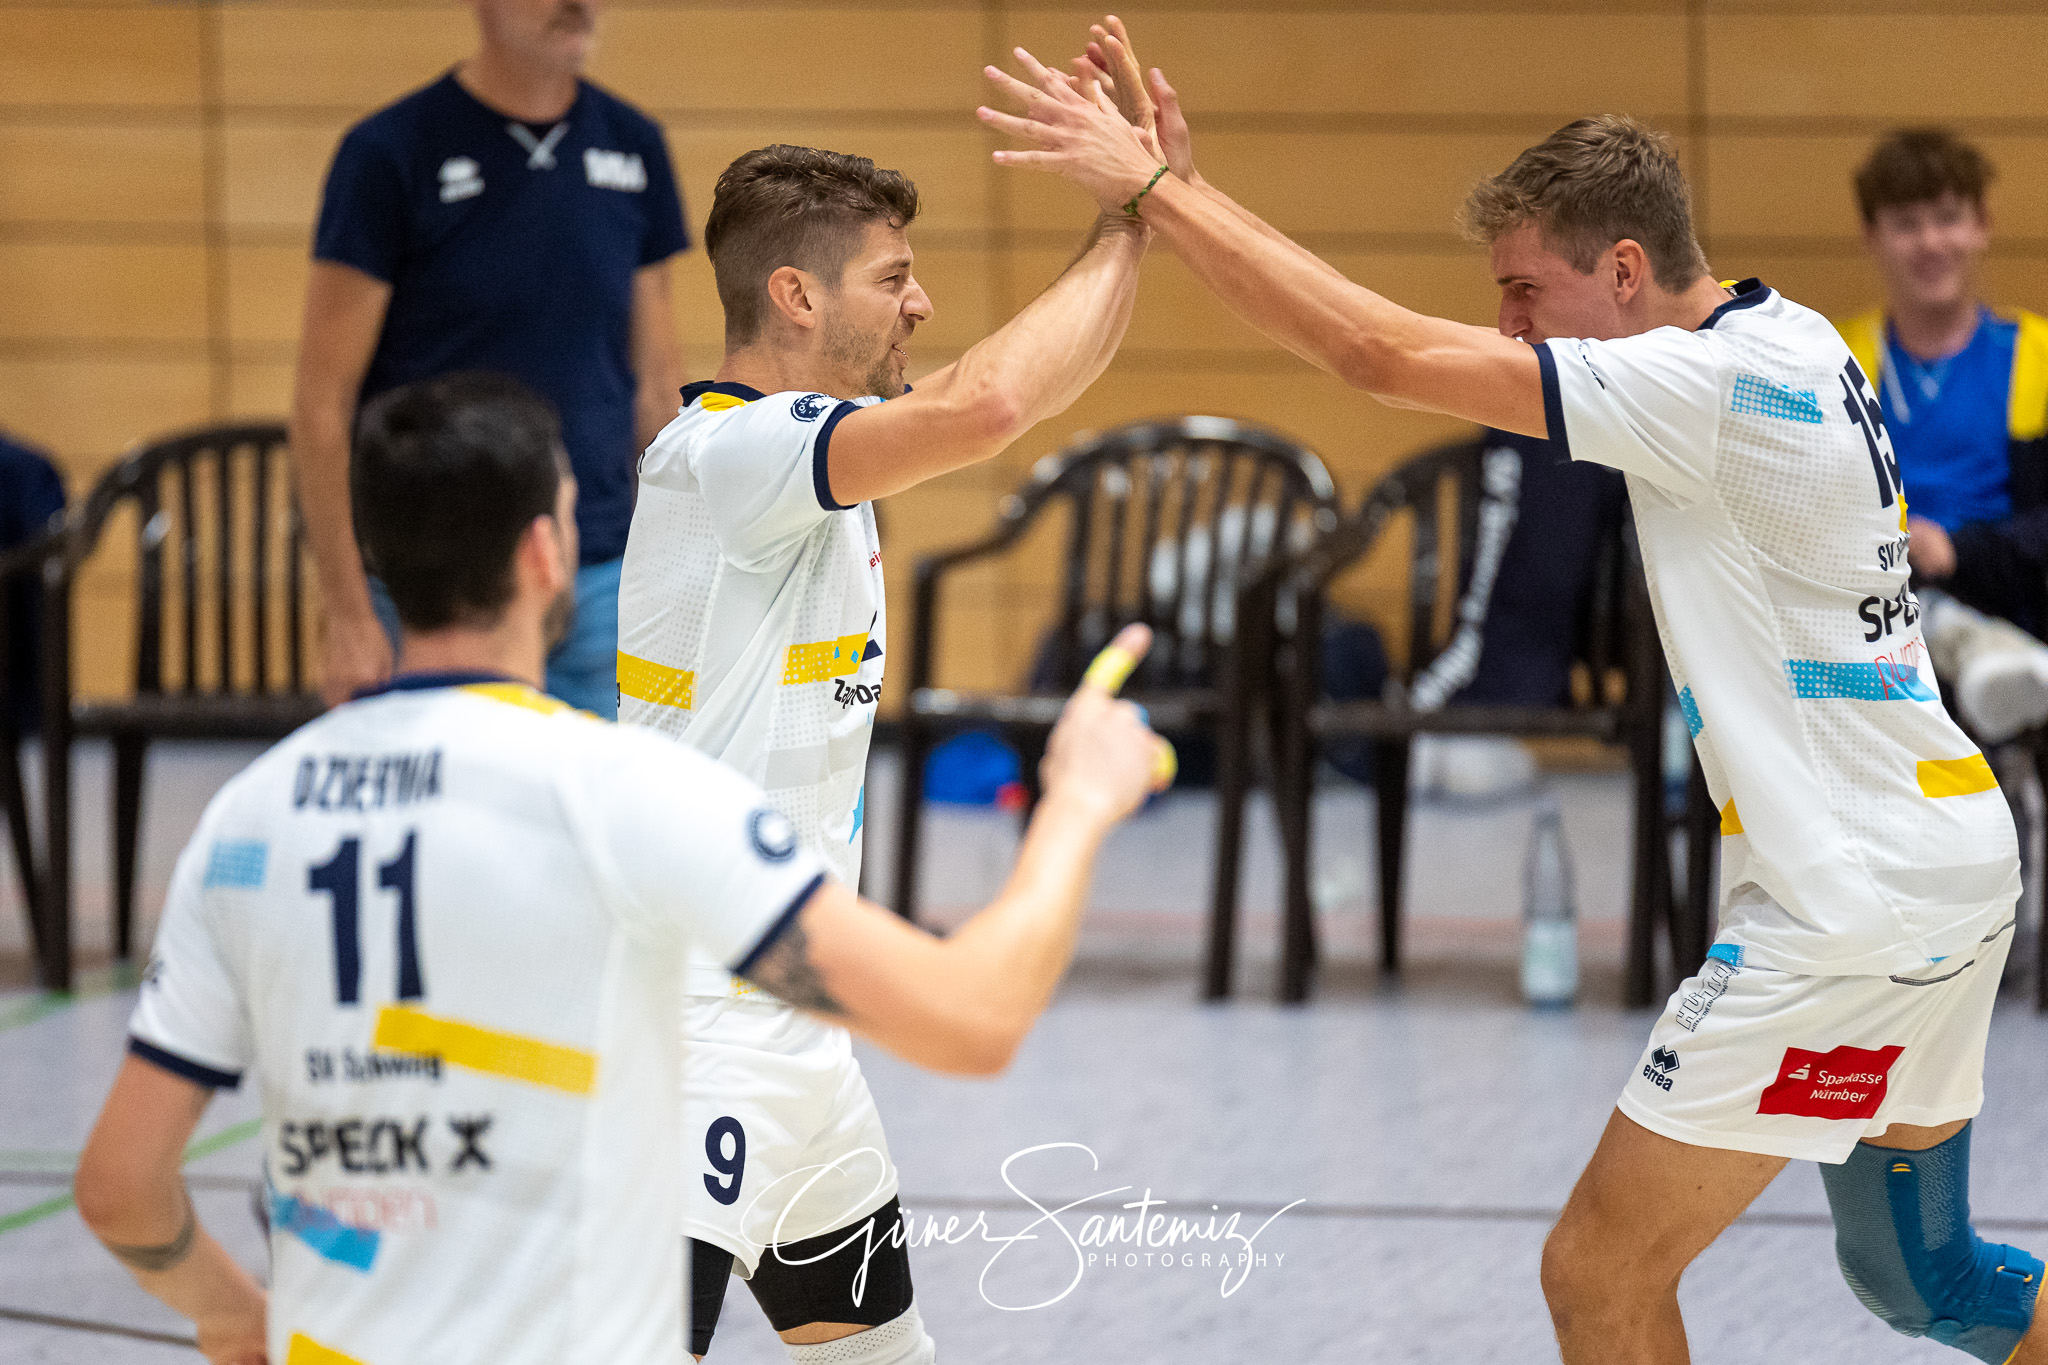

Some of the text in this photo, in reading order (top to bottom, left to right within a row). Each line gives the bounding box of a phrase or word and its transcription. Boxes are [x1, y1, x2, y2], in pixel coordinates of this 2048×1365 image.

[1839, 355, 1902, 509] 15
[1878, 541, 1896, 571] SV
[309, 834, 424, 1004] 11
[1643, 1064, 1674, 1092] errea
[1809, 1089, 1869, 1103] Nürnber
[1816, 1070, 1883, 1087] Sparkasse
[281, 1117, 429, 1176] SPECK
[703, 1116, 746, 1205] 9
